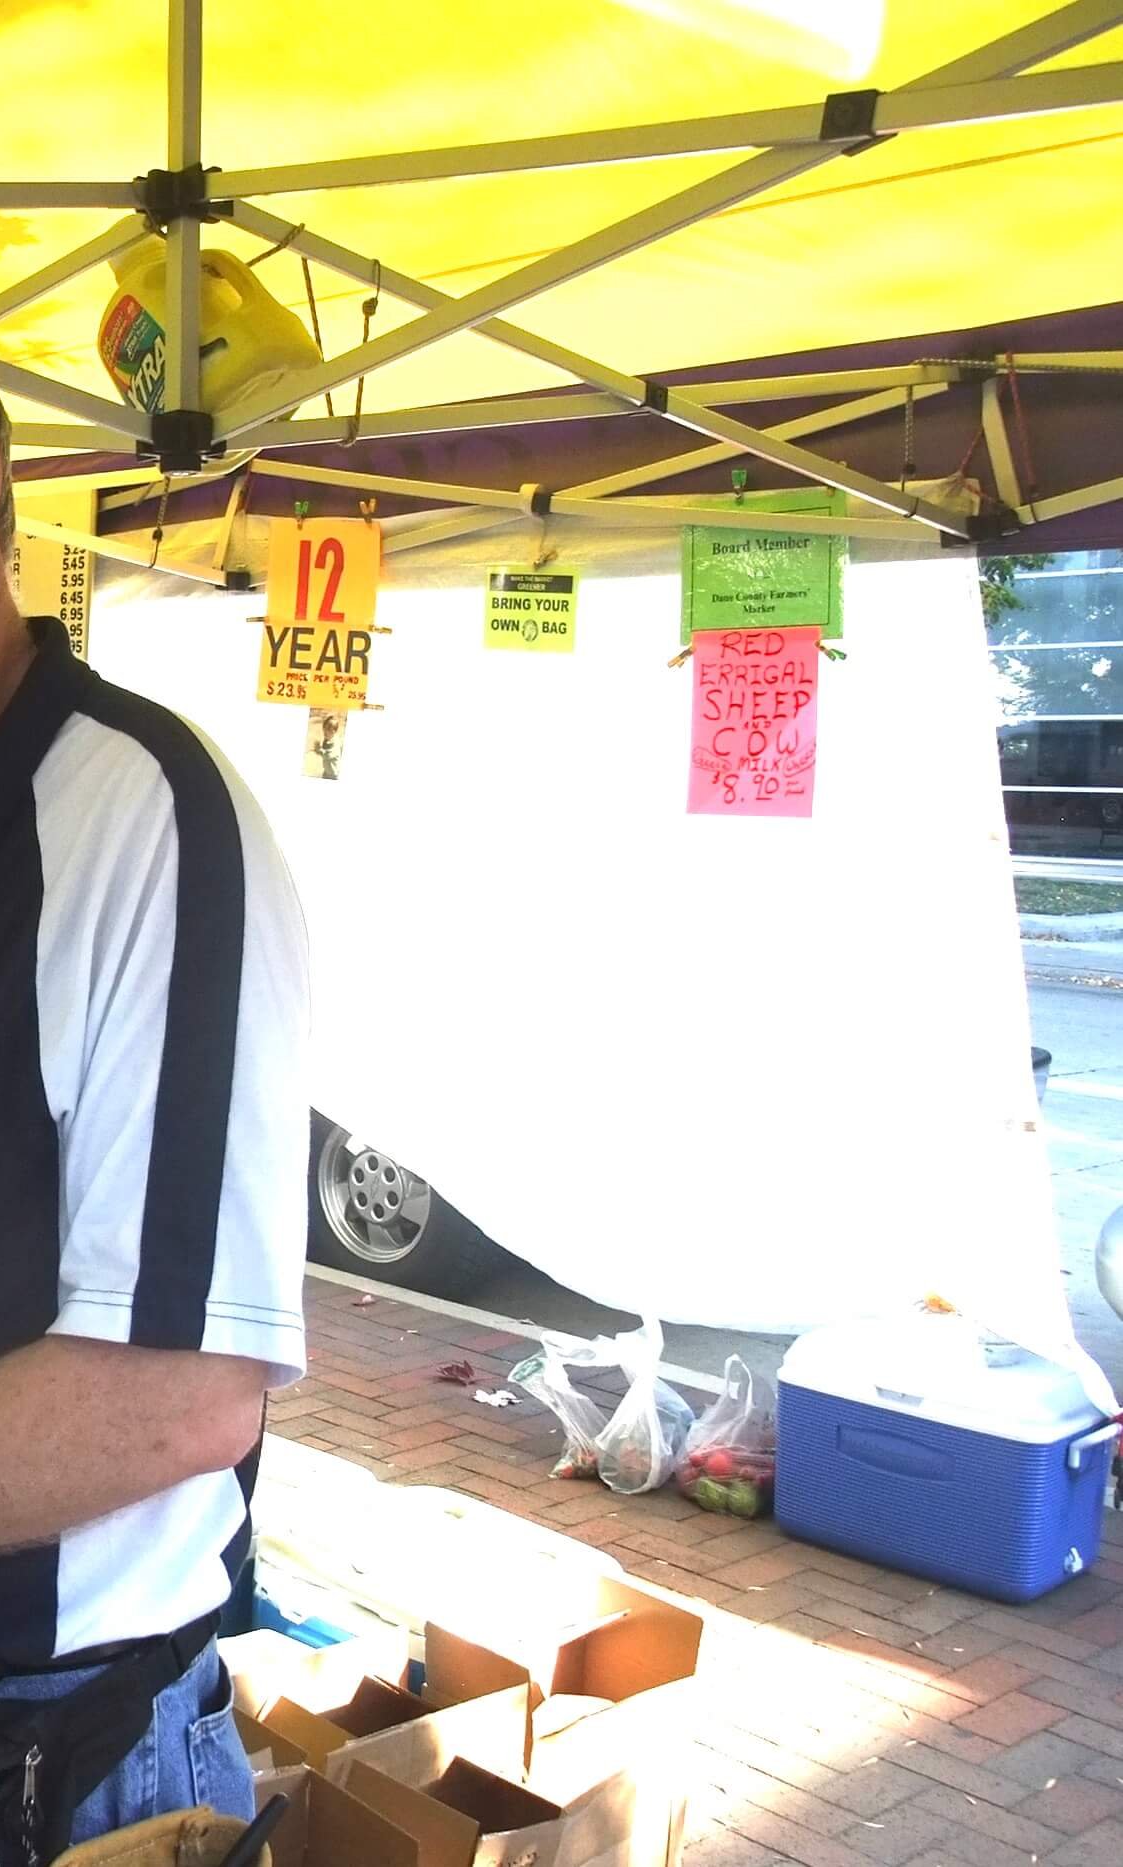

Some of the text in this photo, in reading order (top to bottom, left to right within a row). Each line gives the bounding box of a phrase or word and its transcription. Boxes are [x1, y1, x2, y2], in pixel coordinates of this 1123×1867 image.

[712, 536, 811, 555] Board Member
[61, 574, 84, 588] 5.95
[295, 537, 345, 623] 12
[60, 592, 83, 605] 6.45
[492, 597, 569, 612] BRING YOUR
[59, 608, 83, 621] 6.95
[491, 619, 567, 634] OWN BAG
[265, 625, 372, 675] YEAR
[720, 631, 785, 658] RED
[703, 689, 810, 721] SHEEP
[743, 721, 771, 730] AND
[712, 727, 799, 757] COW
[737, 757, 781, 772] MILK
